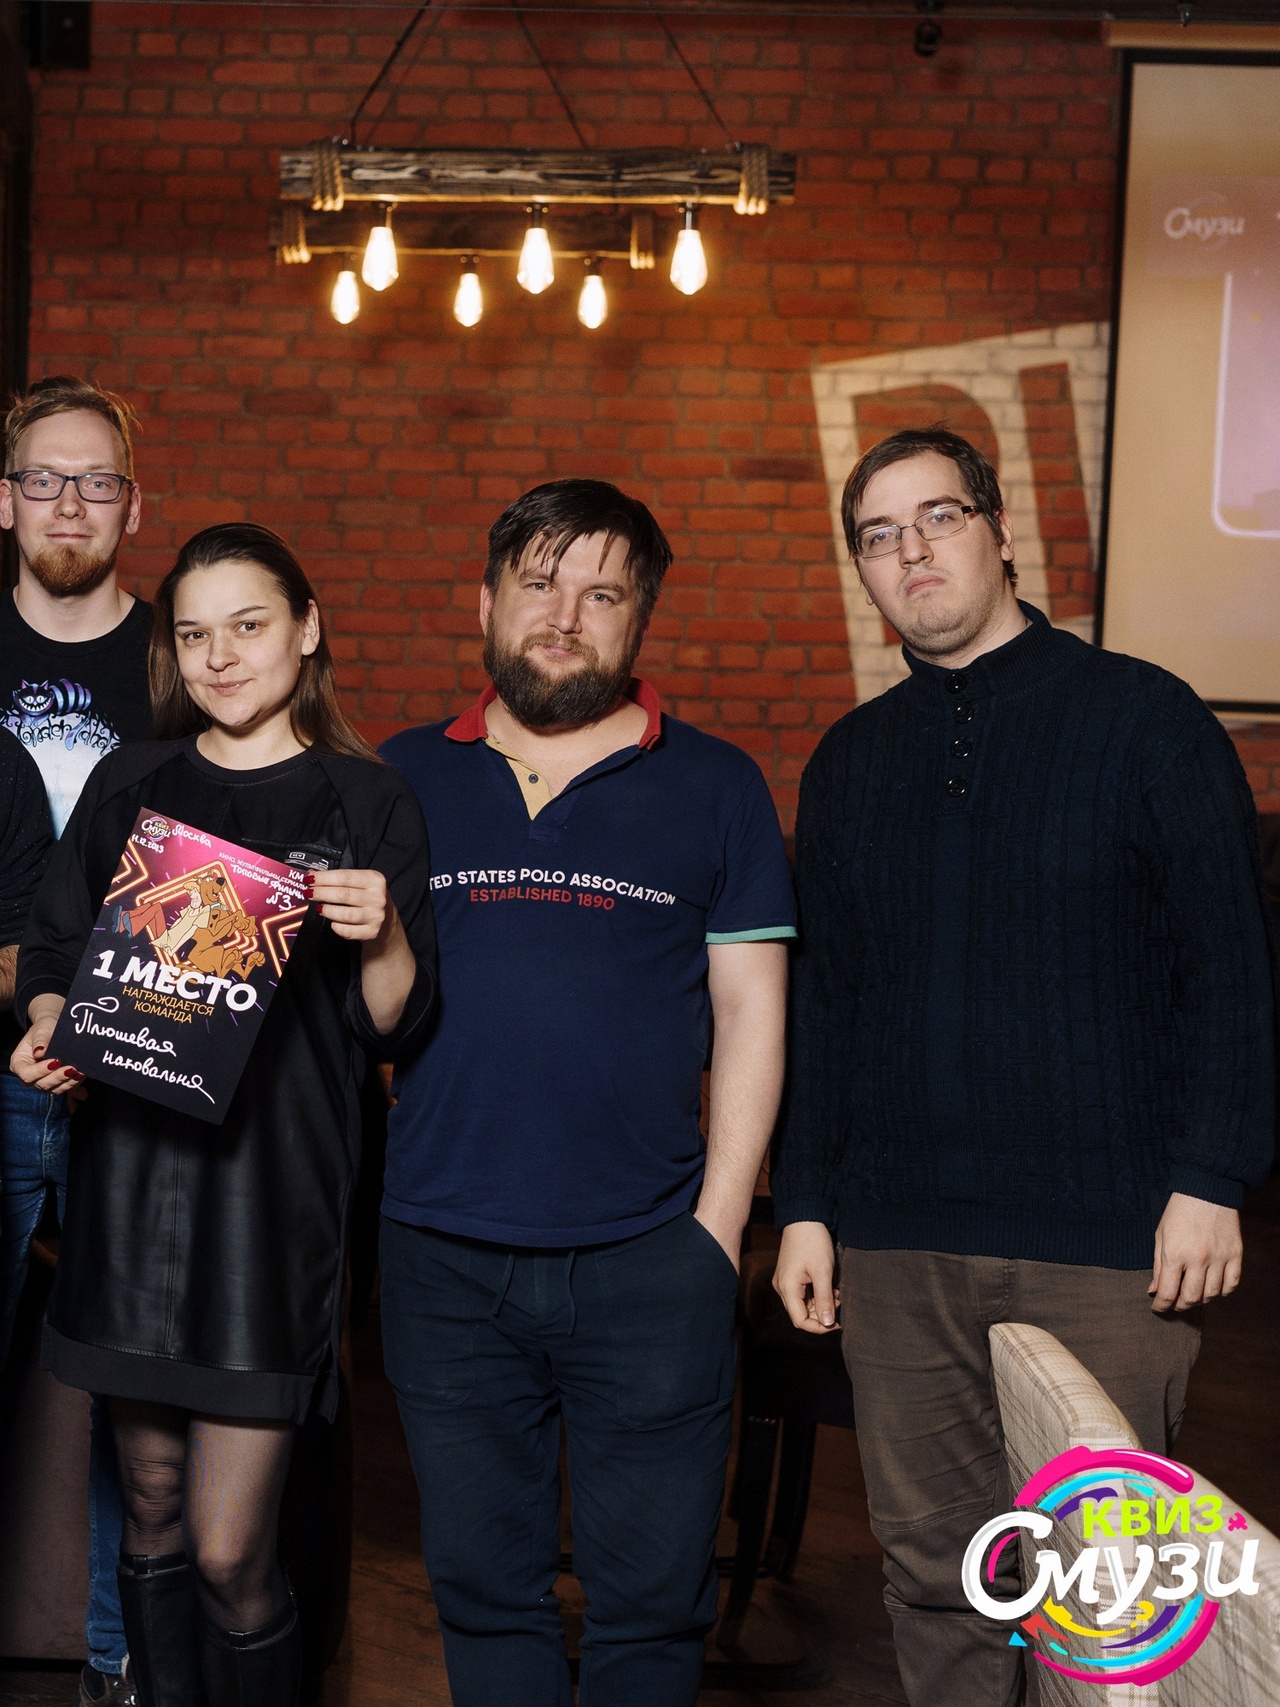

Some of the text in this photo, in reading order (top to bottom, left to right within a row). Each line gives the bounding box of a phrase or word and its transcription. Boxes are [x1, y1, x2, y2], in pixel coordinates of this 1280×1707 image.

[141, 820, 171, 838] Смузи
[172, 824, 212, 848] Москва
[288, 869, 304, 882] КМ
[429, 868, 676, 906] TED STATES POLO ASSOCIATION
[470, 887, 615, 911] ESTABLISHED 1890
[92, 949, 257, 1012] 1 МЕСТО
[122, 985, 215, 1017] НАГРАЖДАЕТСЯ
[133, 1001, 193, 1024] КОМАНДА
[70, 996, 177, 1057] Плюшевая
[102, 1050, 216, 1104] наковальня
